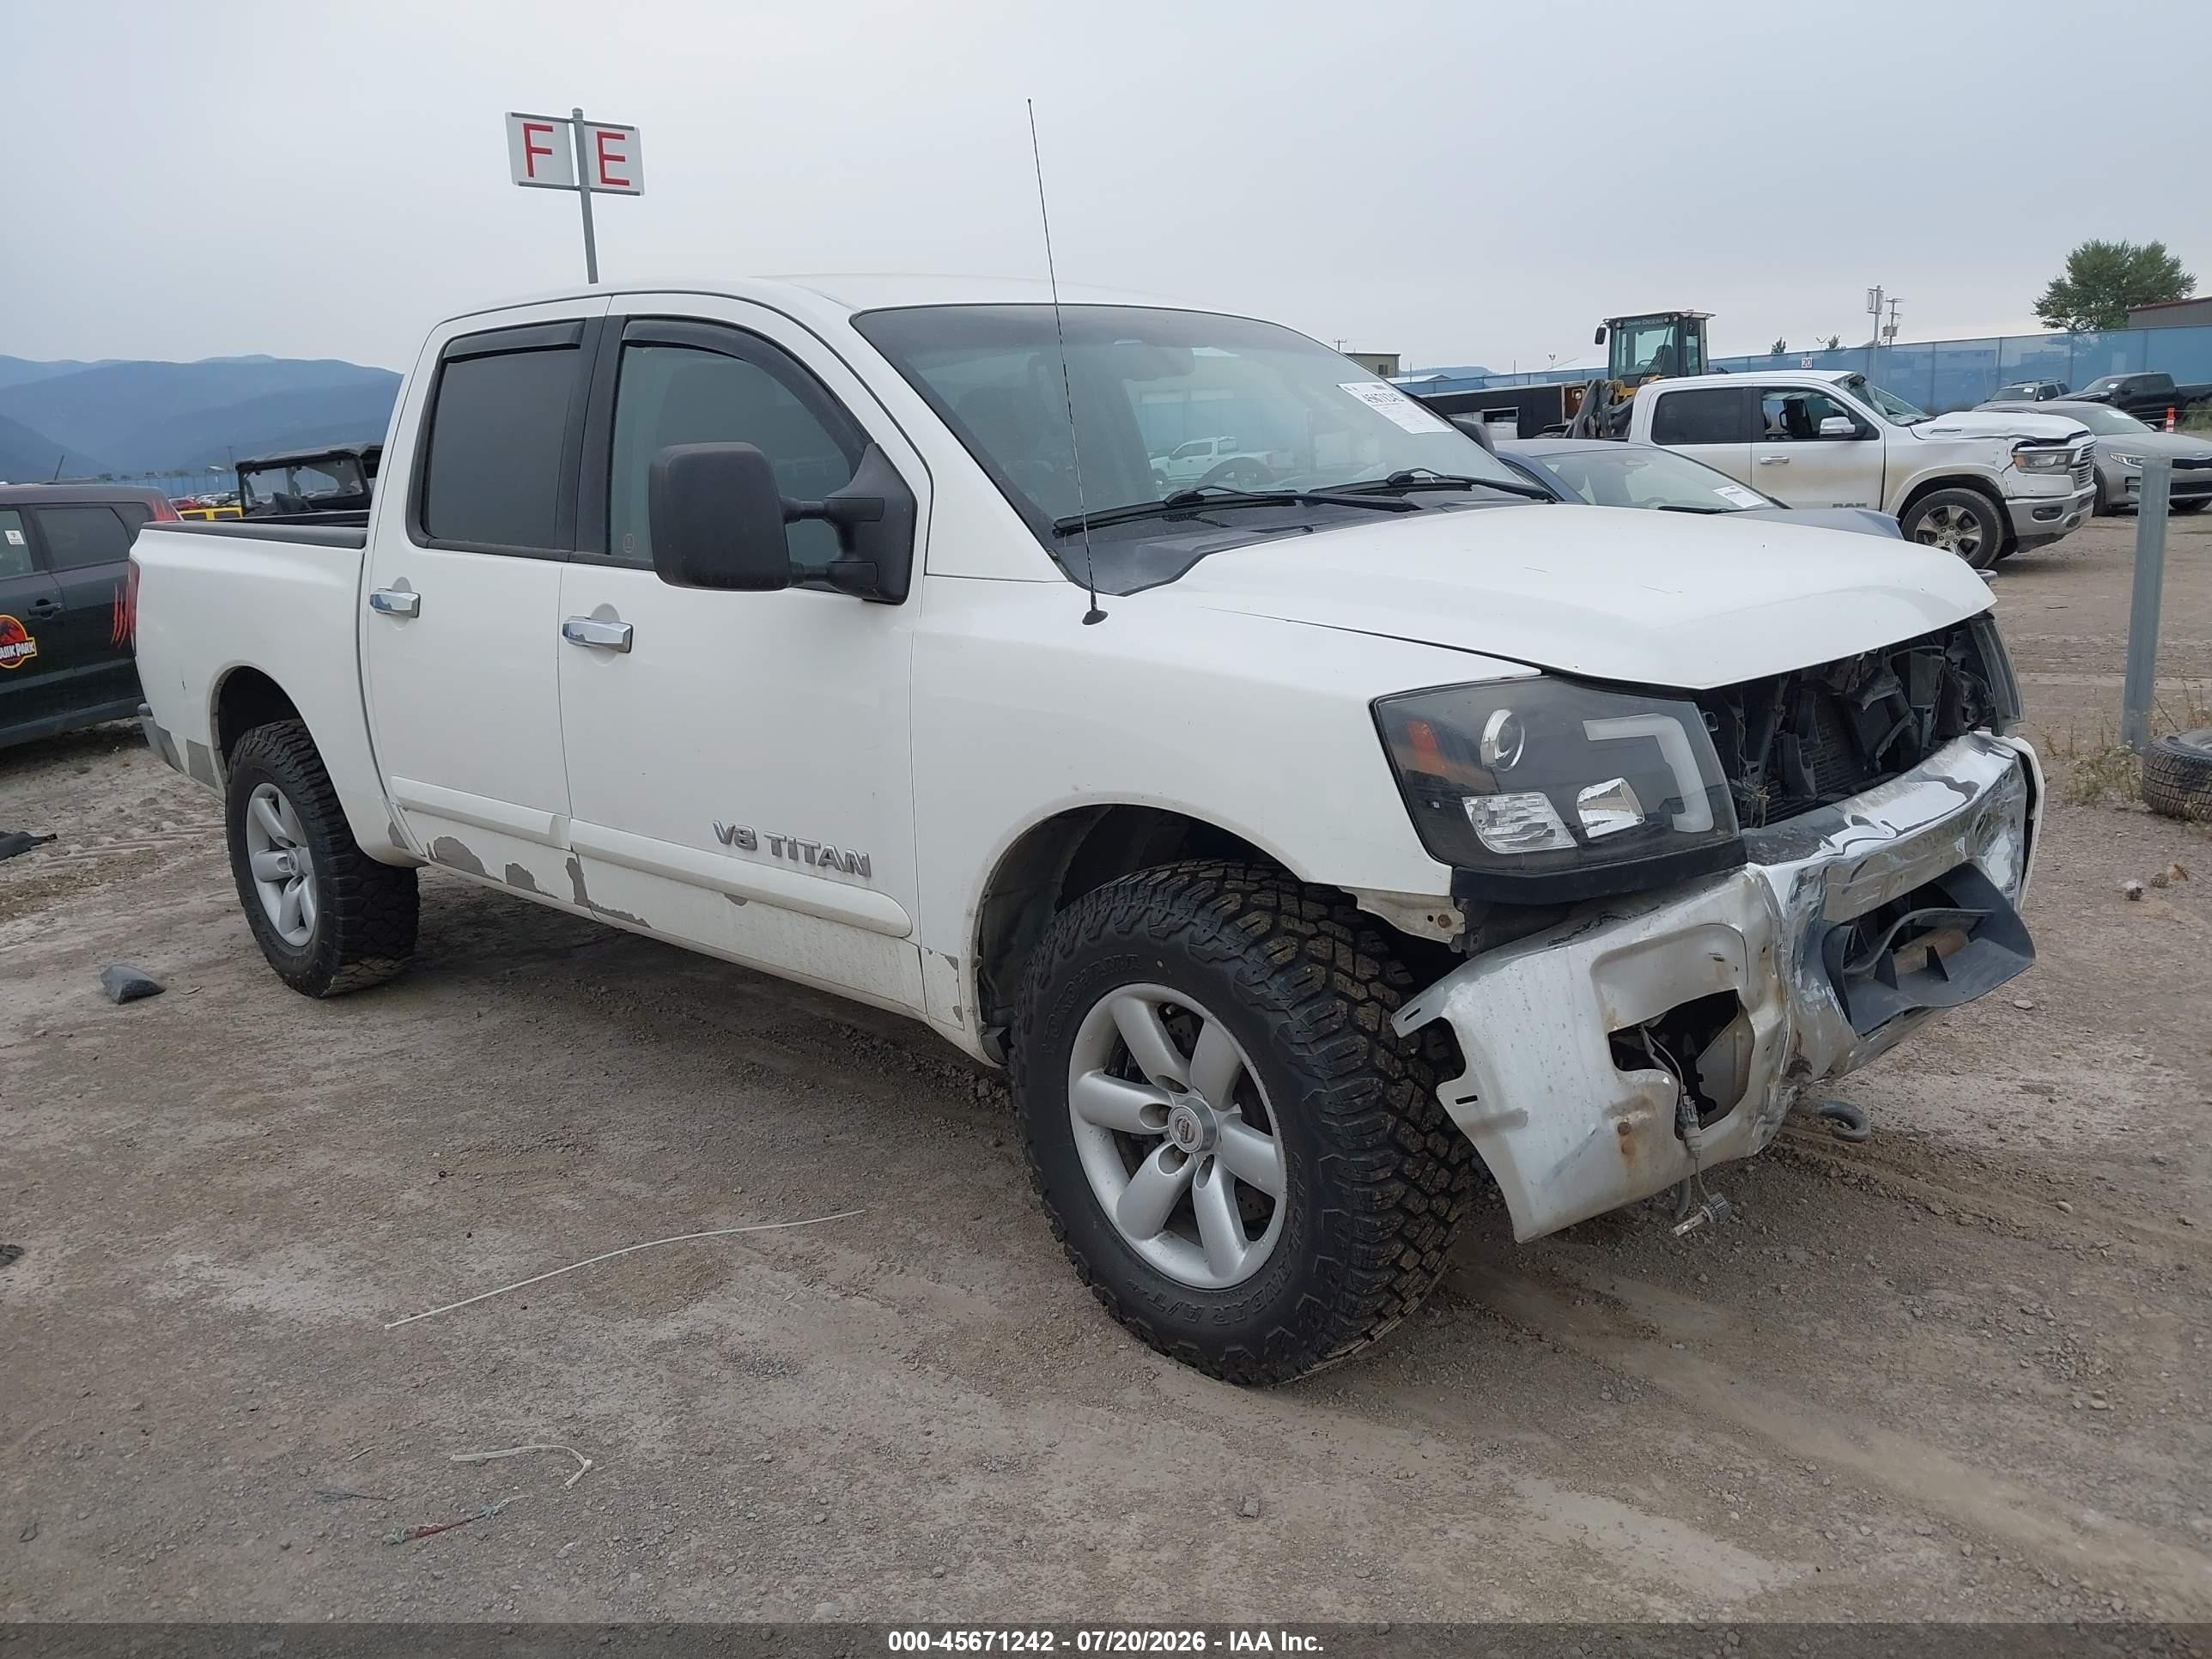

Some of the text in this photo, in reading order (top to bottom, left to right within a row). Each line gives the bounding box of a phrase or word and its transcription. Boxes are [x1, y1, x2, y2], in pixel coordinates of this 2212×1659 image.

[523, 123, 554, 178] F
[597, 131, 629, 186] E
[1802, 358, 1811, 368] 20
[15, 641, 34, 657] PARK
[713, 819, 871, 878] V8 TITAN
